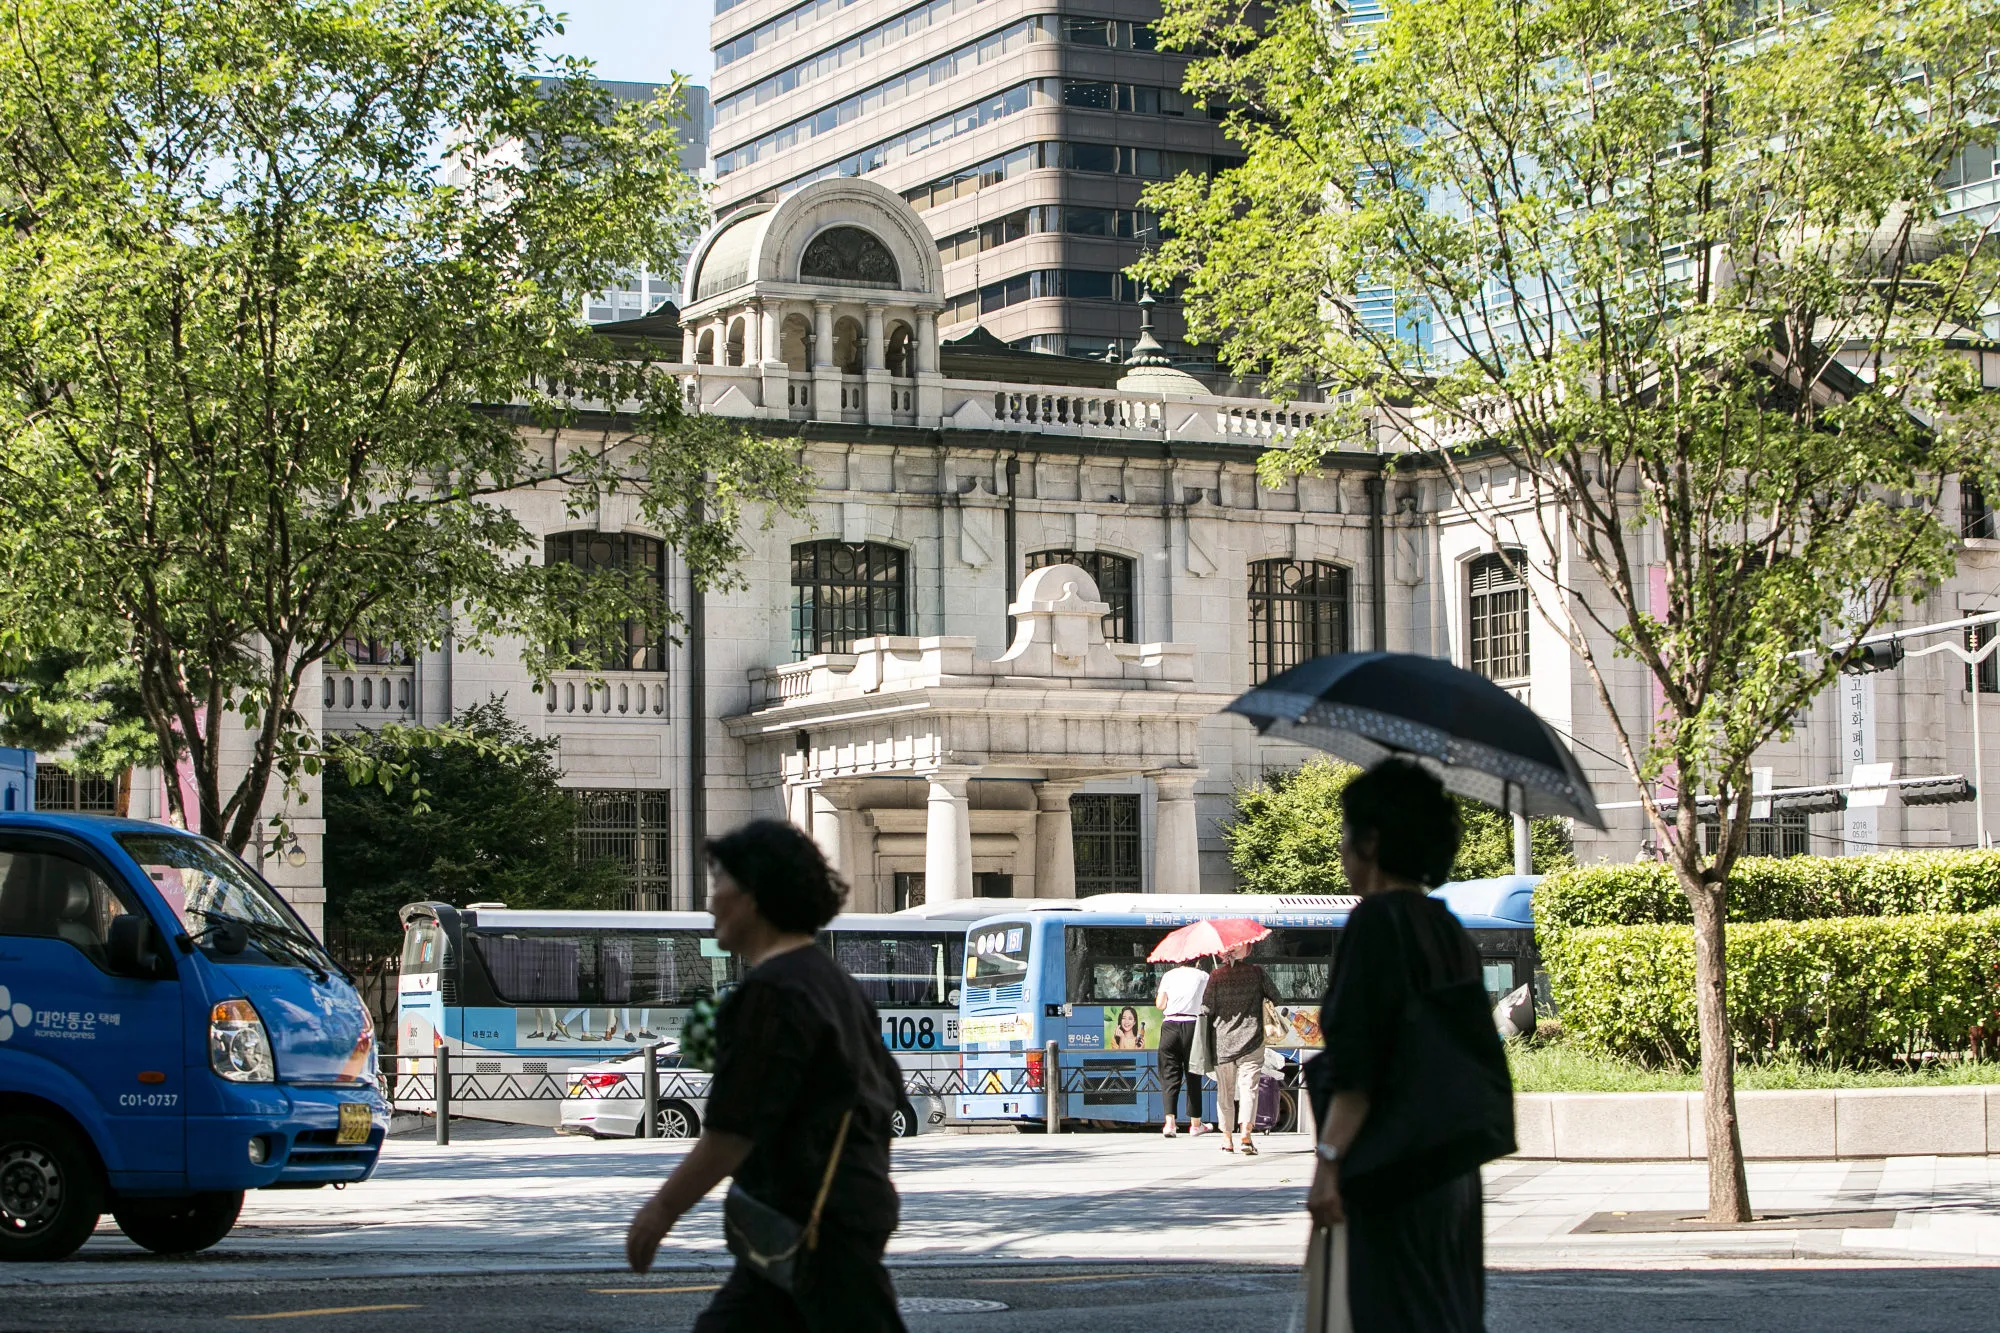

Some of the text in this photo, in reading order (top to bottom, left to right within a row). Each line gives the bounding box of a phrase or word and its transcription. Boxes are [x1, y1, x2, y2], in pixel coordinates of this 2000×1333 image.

[1852, 821, 1867, 830] 2018
[1008, 931, 1021, 950] 151
[36, 1011, 97, 1030] 대한통운
[472, 1030, 500, 1039] 대원고속
[1068, 1034, 1100, 1043] 동아운수
[119, 1094, 178, 1106] C01-0737
